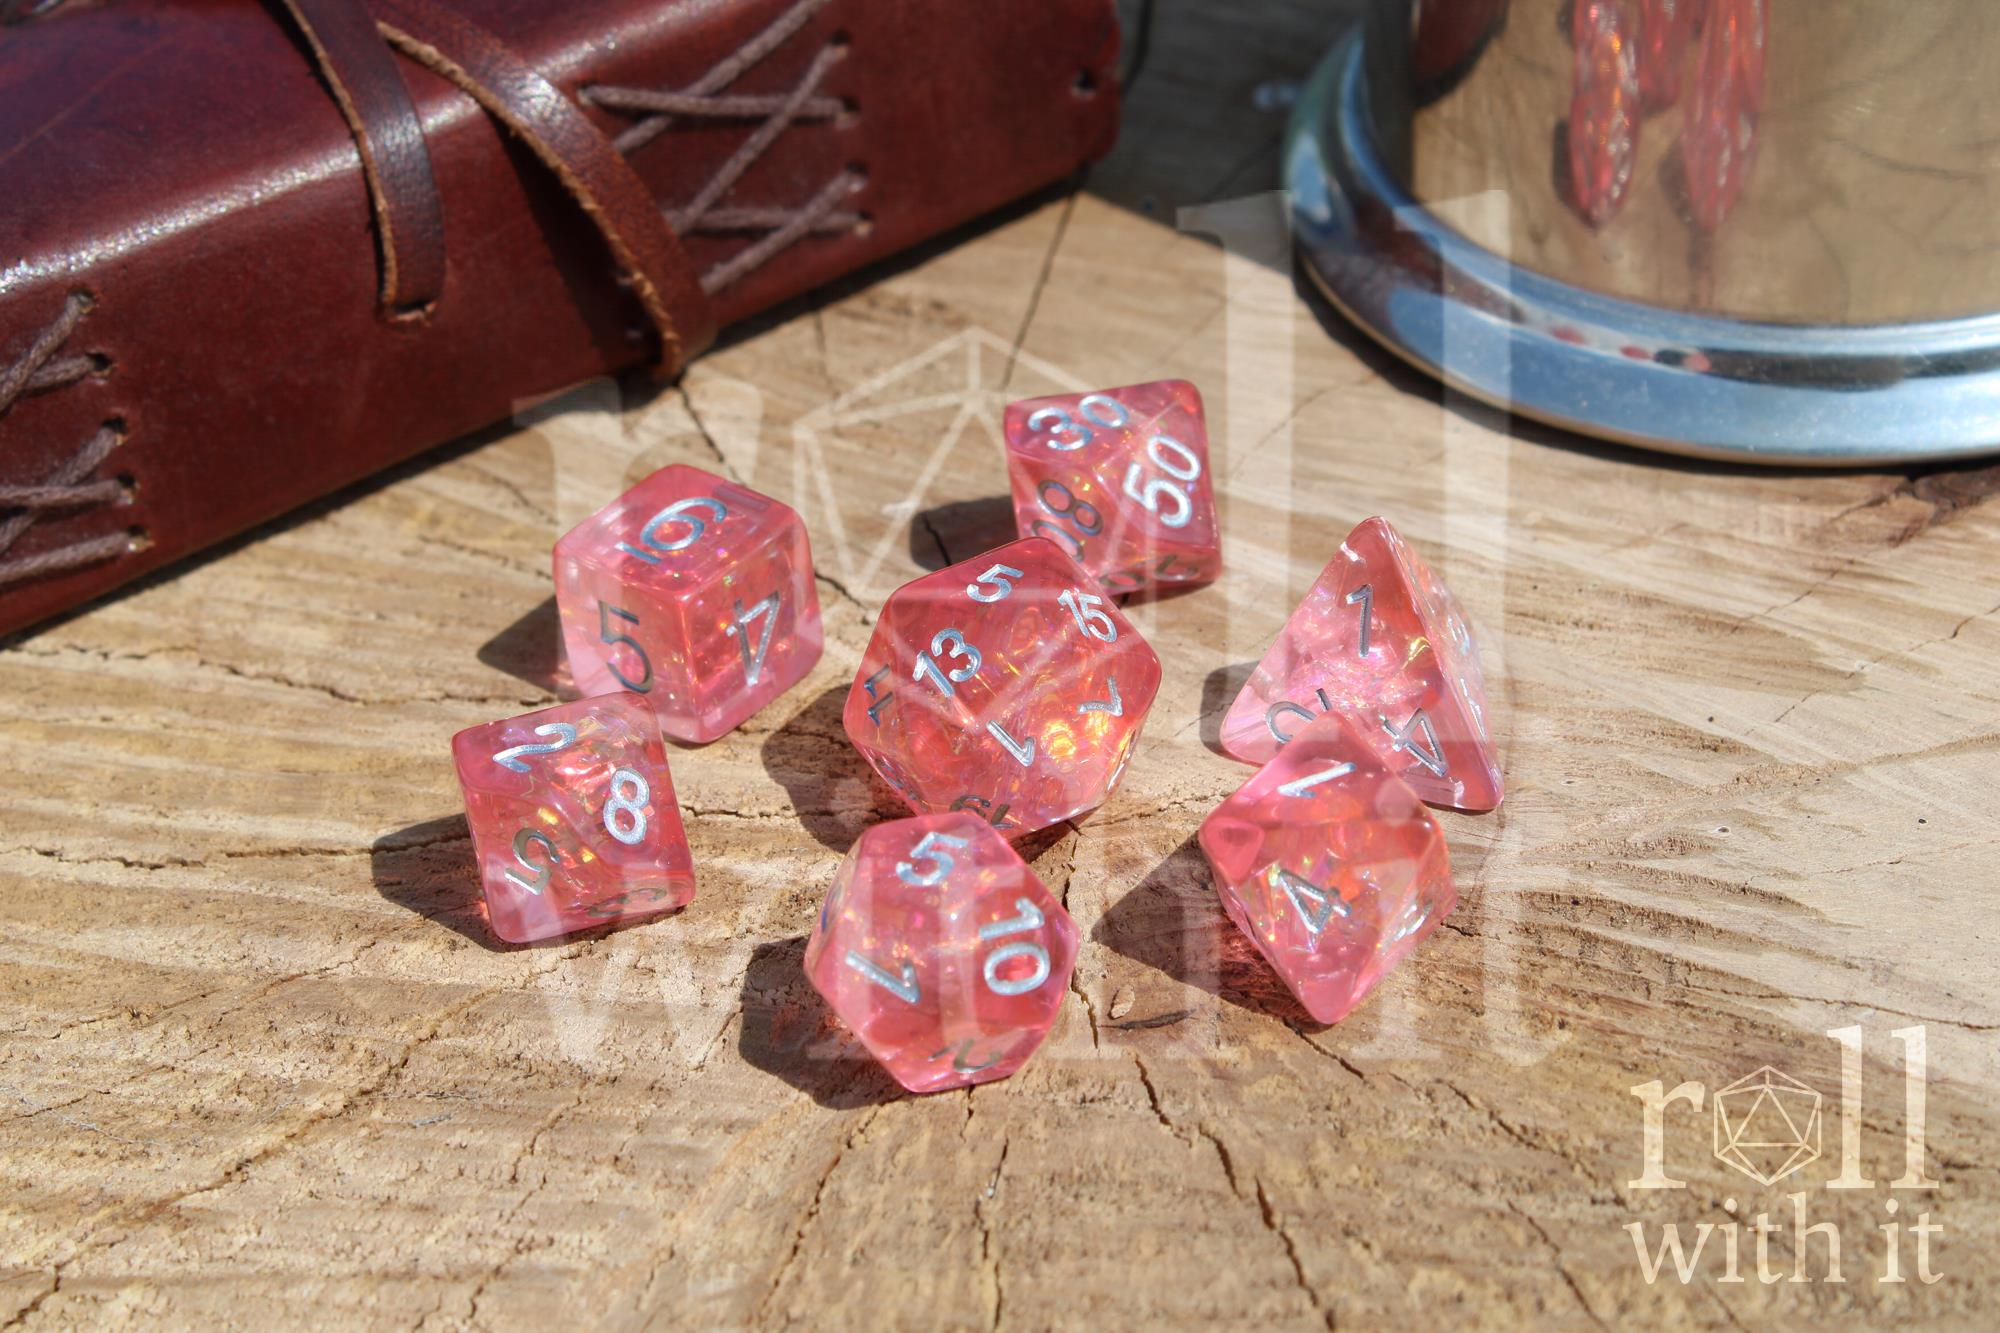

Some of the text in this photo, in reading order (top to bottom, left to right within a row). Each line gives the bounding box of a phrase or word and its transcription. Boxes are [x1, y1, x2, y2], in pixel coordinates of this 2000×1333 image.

[1028, 394, 1131, 451] 30
[1123, 434, 1202, 529] 50
[617, 497, 728, 563] 6
[966, 564, 1025, 603] 5
[1057, 589, 1118, 643] 15
[598, 600, 653, 694] 5
[724, 591, 781, 687] 4
[1345, 584, 1373, 658] 1
[912, 627, 983, 698] 13
[492, 722, 577, 773] 2
[1378, 707, 1449, 778] 4
[602, 767, 651, 846] 8
[896, 831, 969, 886] 5
[1278, 868, 1353, 934] 4
[979, 896, 1052, 996] 10
